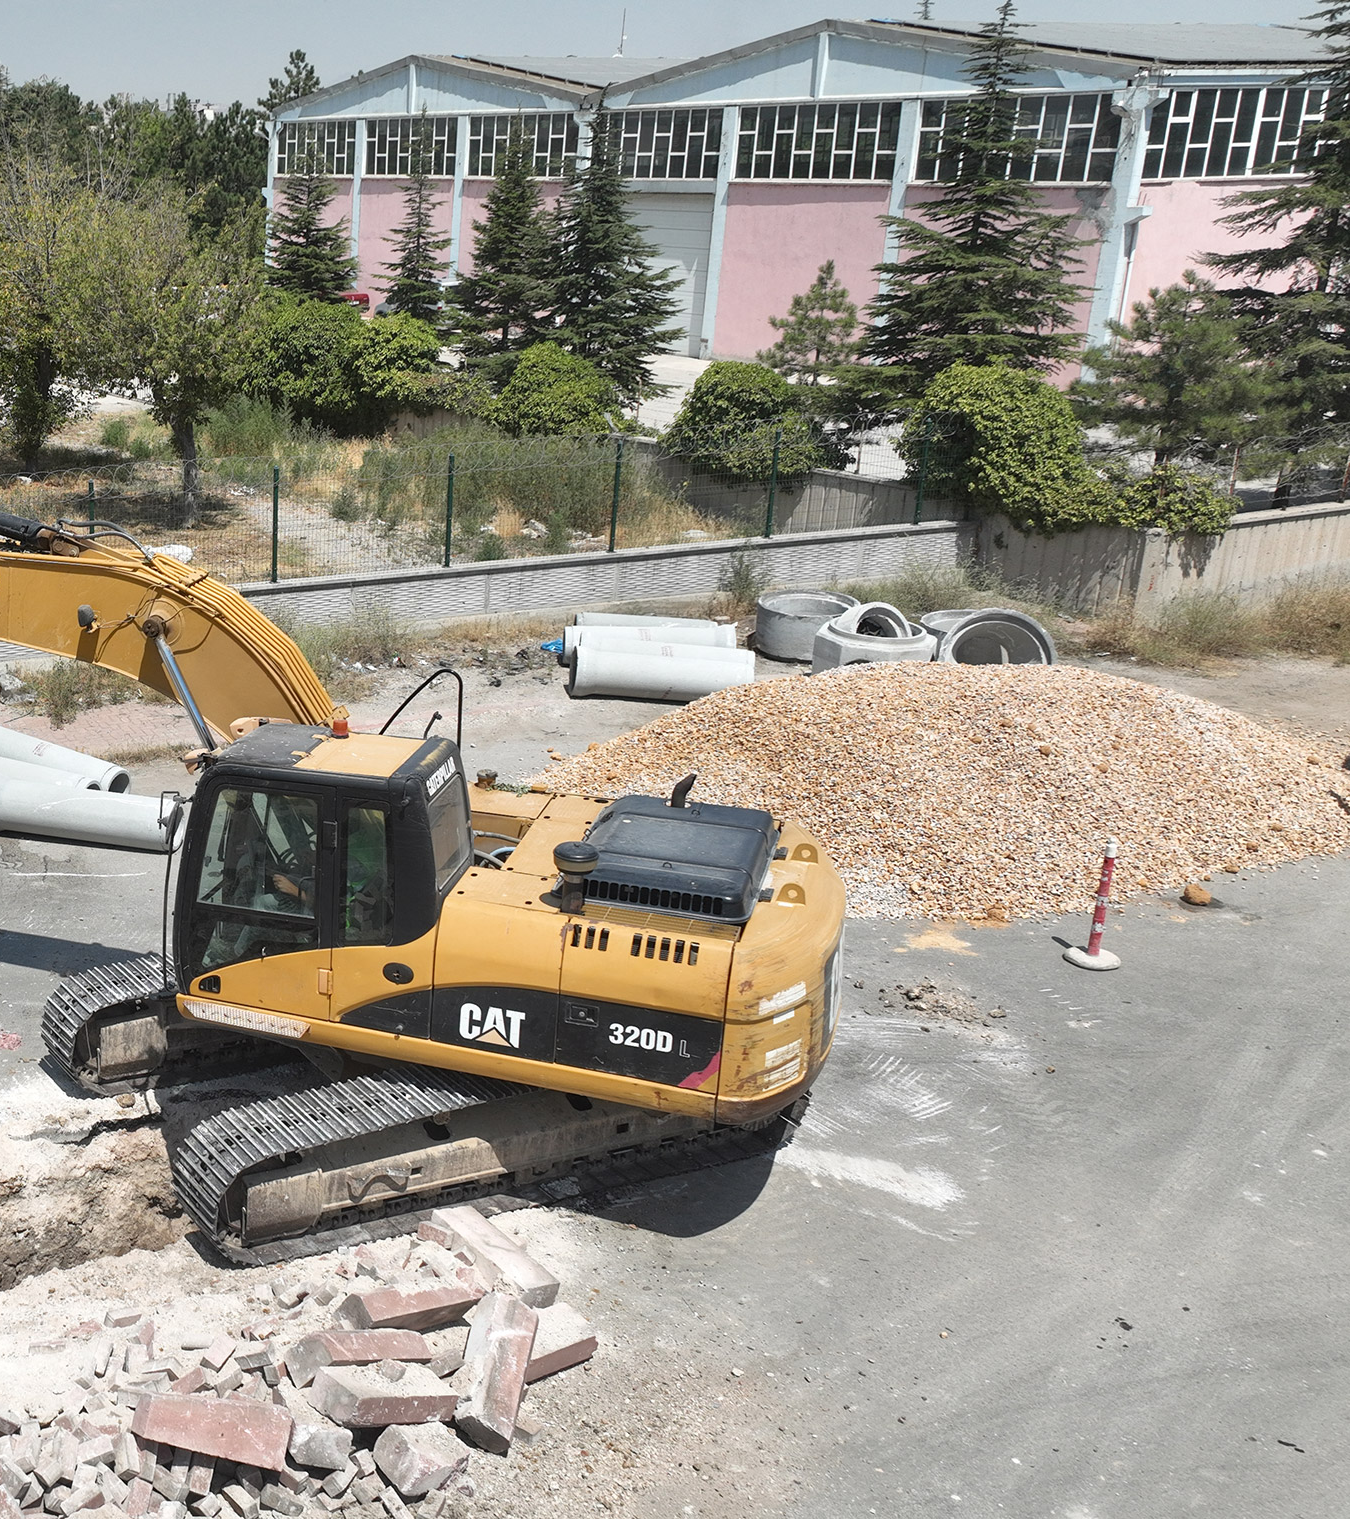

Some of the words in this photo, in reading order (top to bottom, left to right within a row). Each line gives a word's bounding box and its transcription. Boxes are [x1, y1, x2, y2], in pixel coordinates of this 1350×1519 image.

[459, 1002, 526, 1049] CAT
[608, 1022, 673, 1053] 320D
[678, 1039, 691, 1058] L
